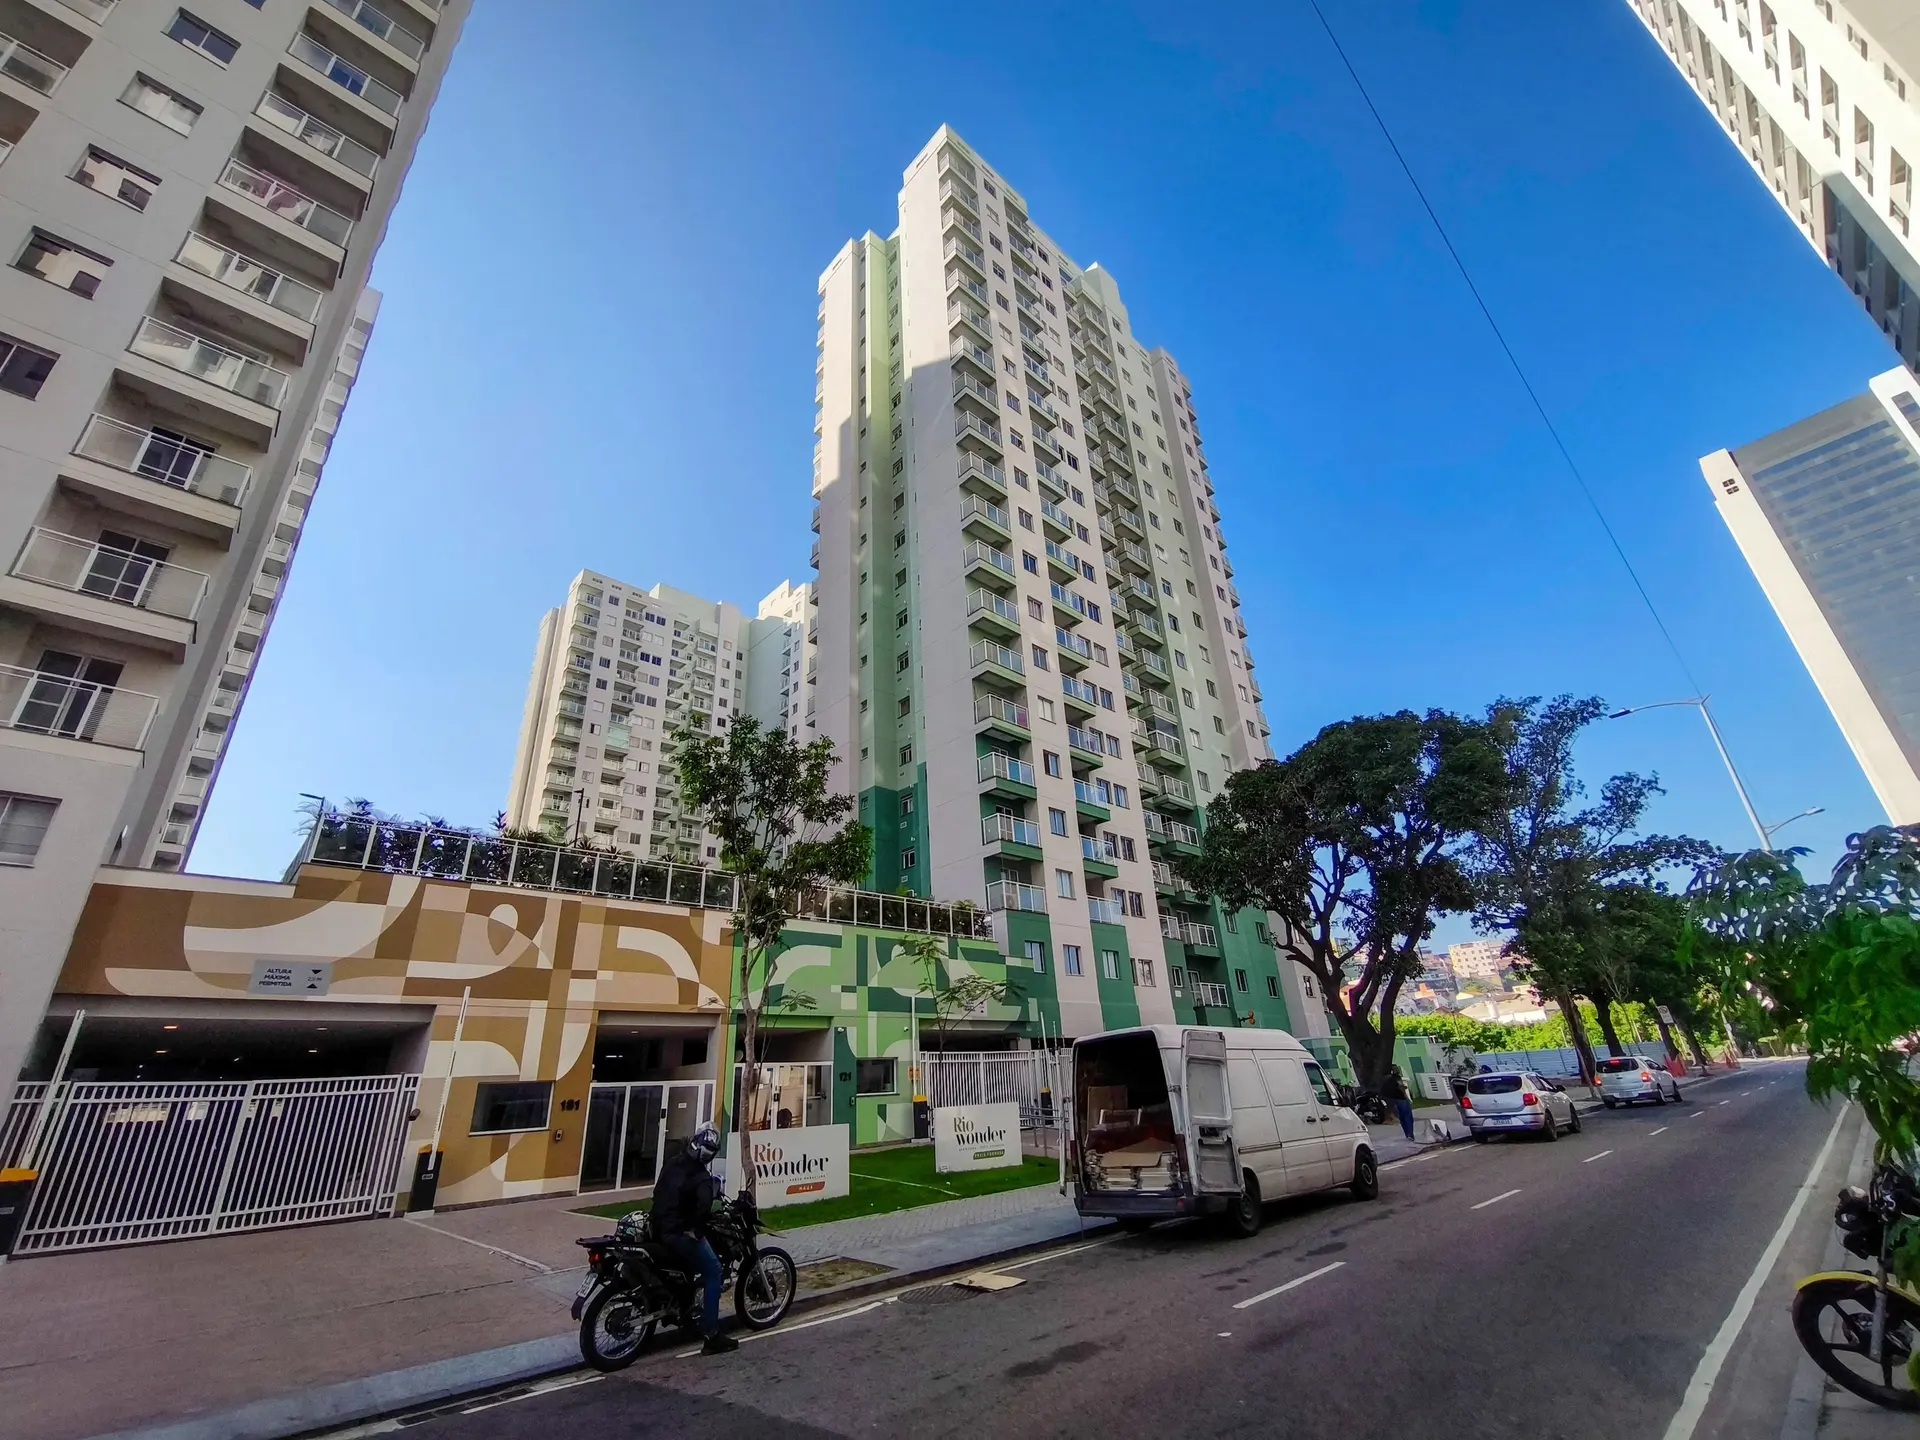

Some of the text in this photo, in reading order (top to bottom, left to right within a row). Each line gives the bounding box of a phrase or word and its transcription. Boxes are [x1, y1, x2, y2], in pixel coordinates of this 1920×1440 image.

[953, 1116, 974, 1133] Rio
[956, 1126, 1006, 1146] wonder
[754, 1142, 784, 1163] Rio
[756, 1154, 829, 1179] wonder
